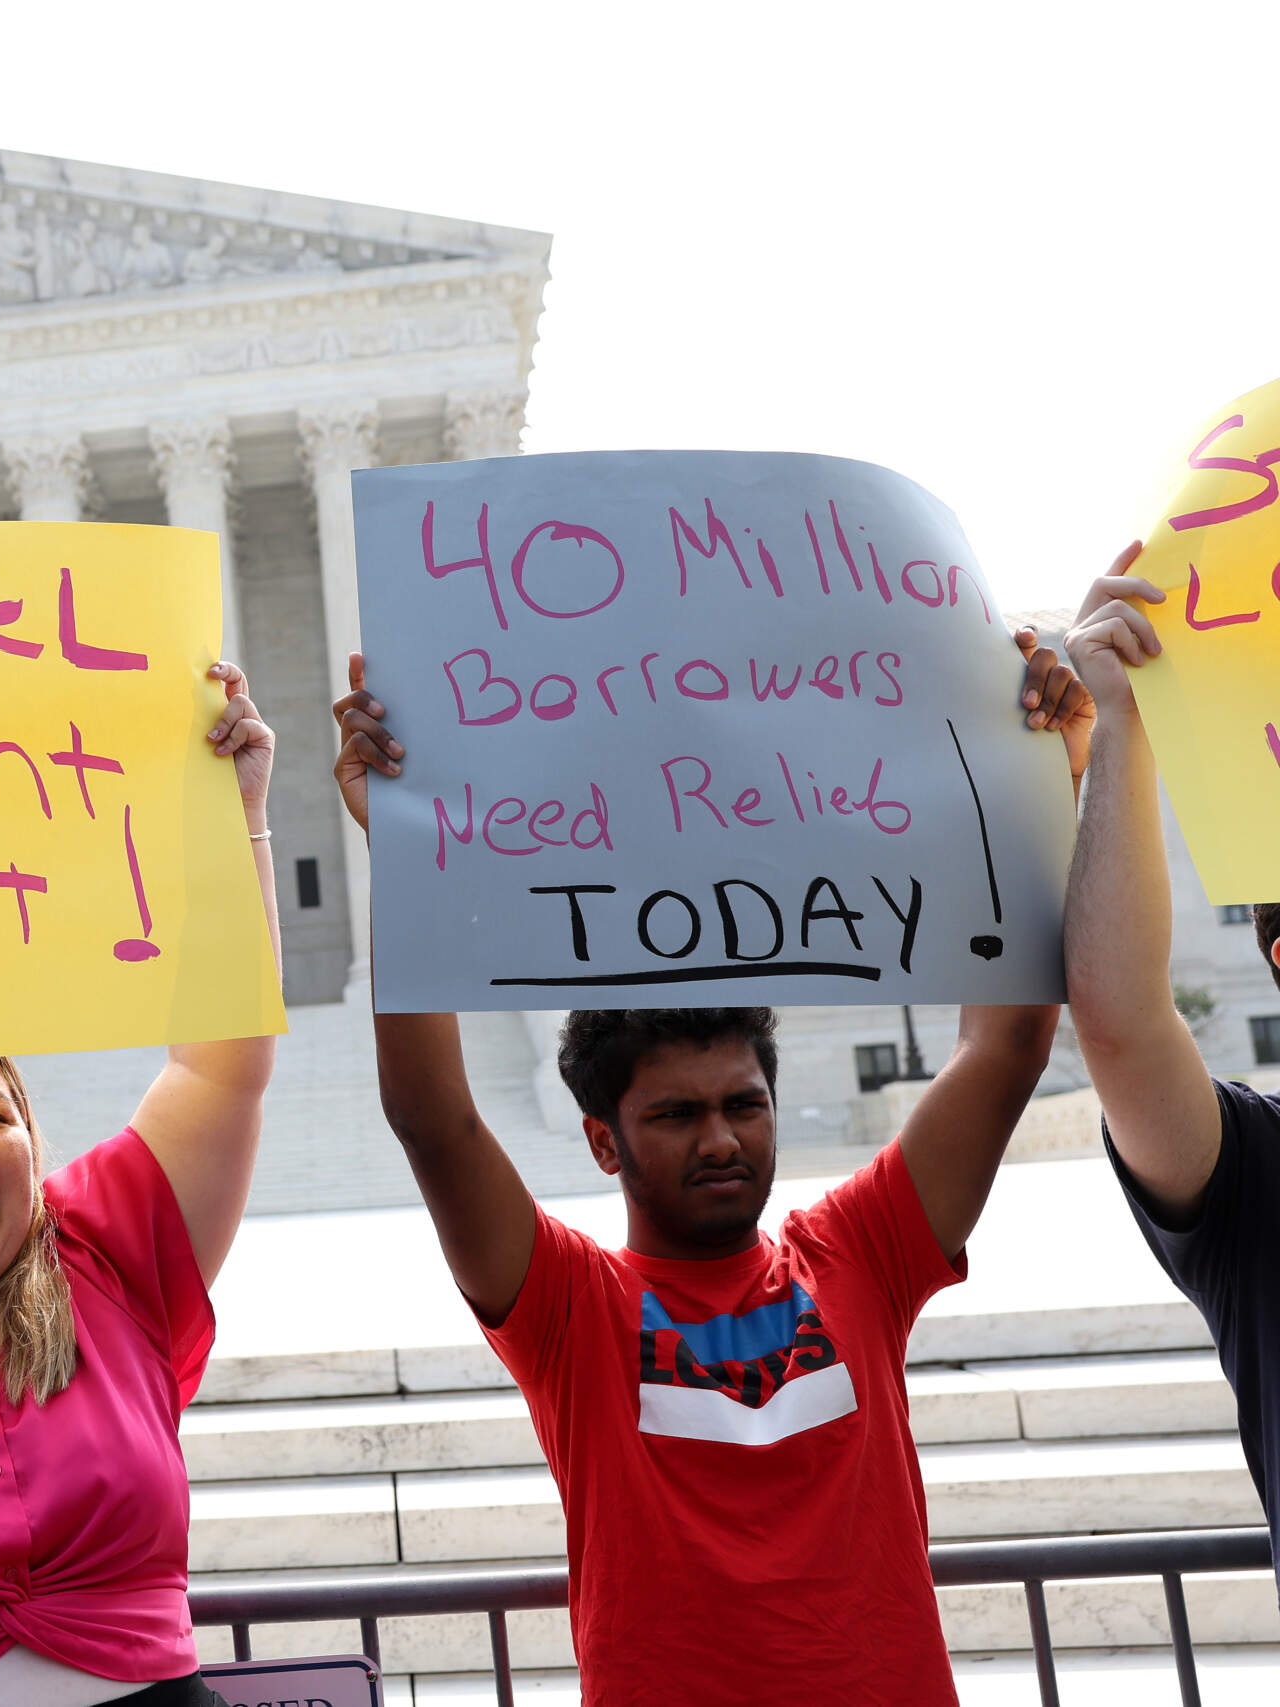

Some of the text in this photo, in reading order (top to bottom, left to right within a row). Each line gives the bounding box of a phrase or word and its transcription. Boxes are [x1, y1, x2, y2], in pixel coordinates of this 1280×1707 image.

[421, 498, 991, 631] 40 Million
[443, 648, 903, 726] Borrowers
[433, 783, 614, 872] Need
